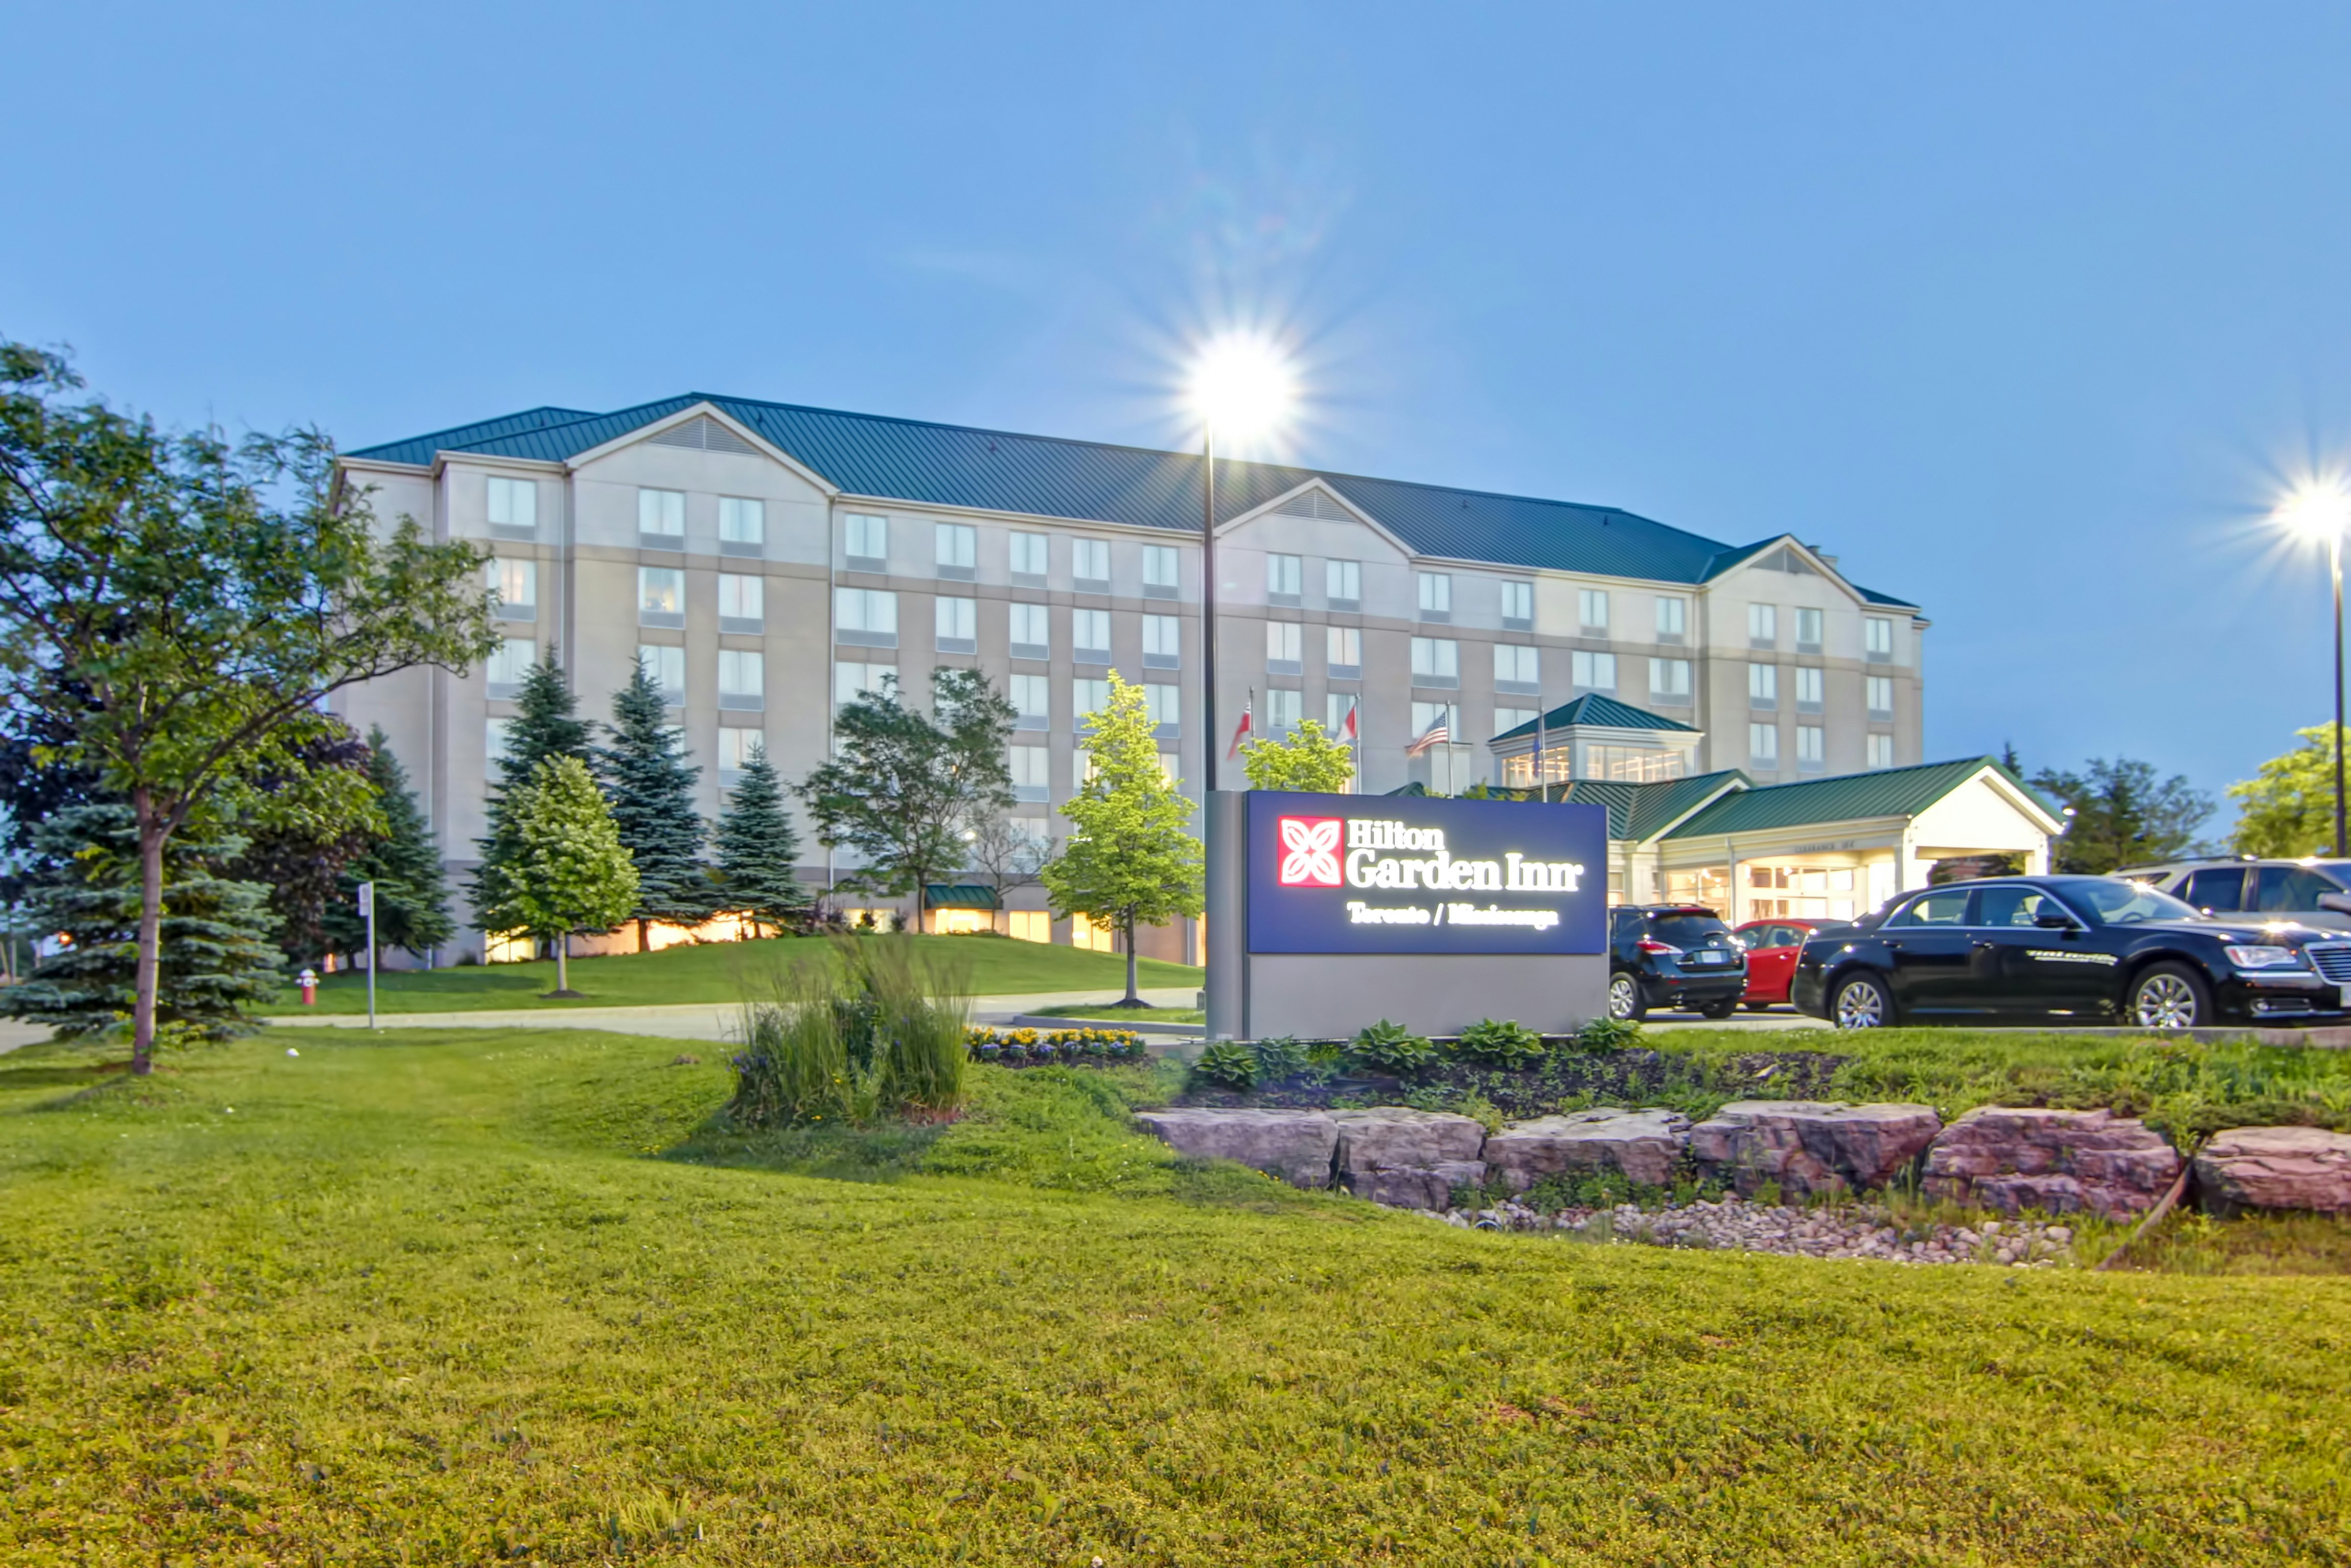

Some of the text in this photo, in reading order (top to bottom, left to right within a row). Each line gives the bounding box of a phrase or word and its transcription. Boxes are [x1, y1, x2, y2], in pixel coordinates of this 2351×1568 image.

[1348, 819, 1445, 850] Hilton
[1346, 849, 1583, 891] Garden Inn
